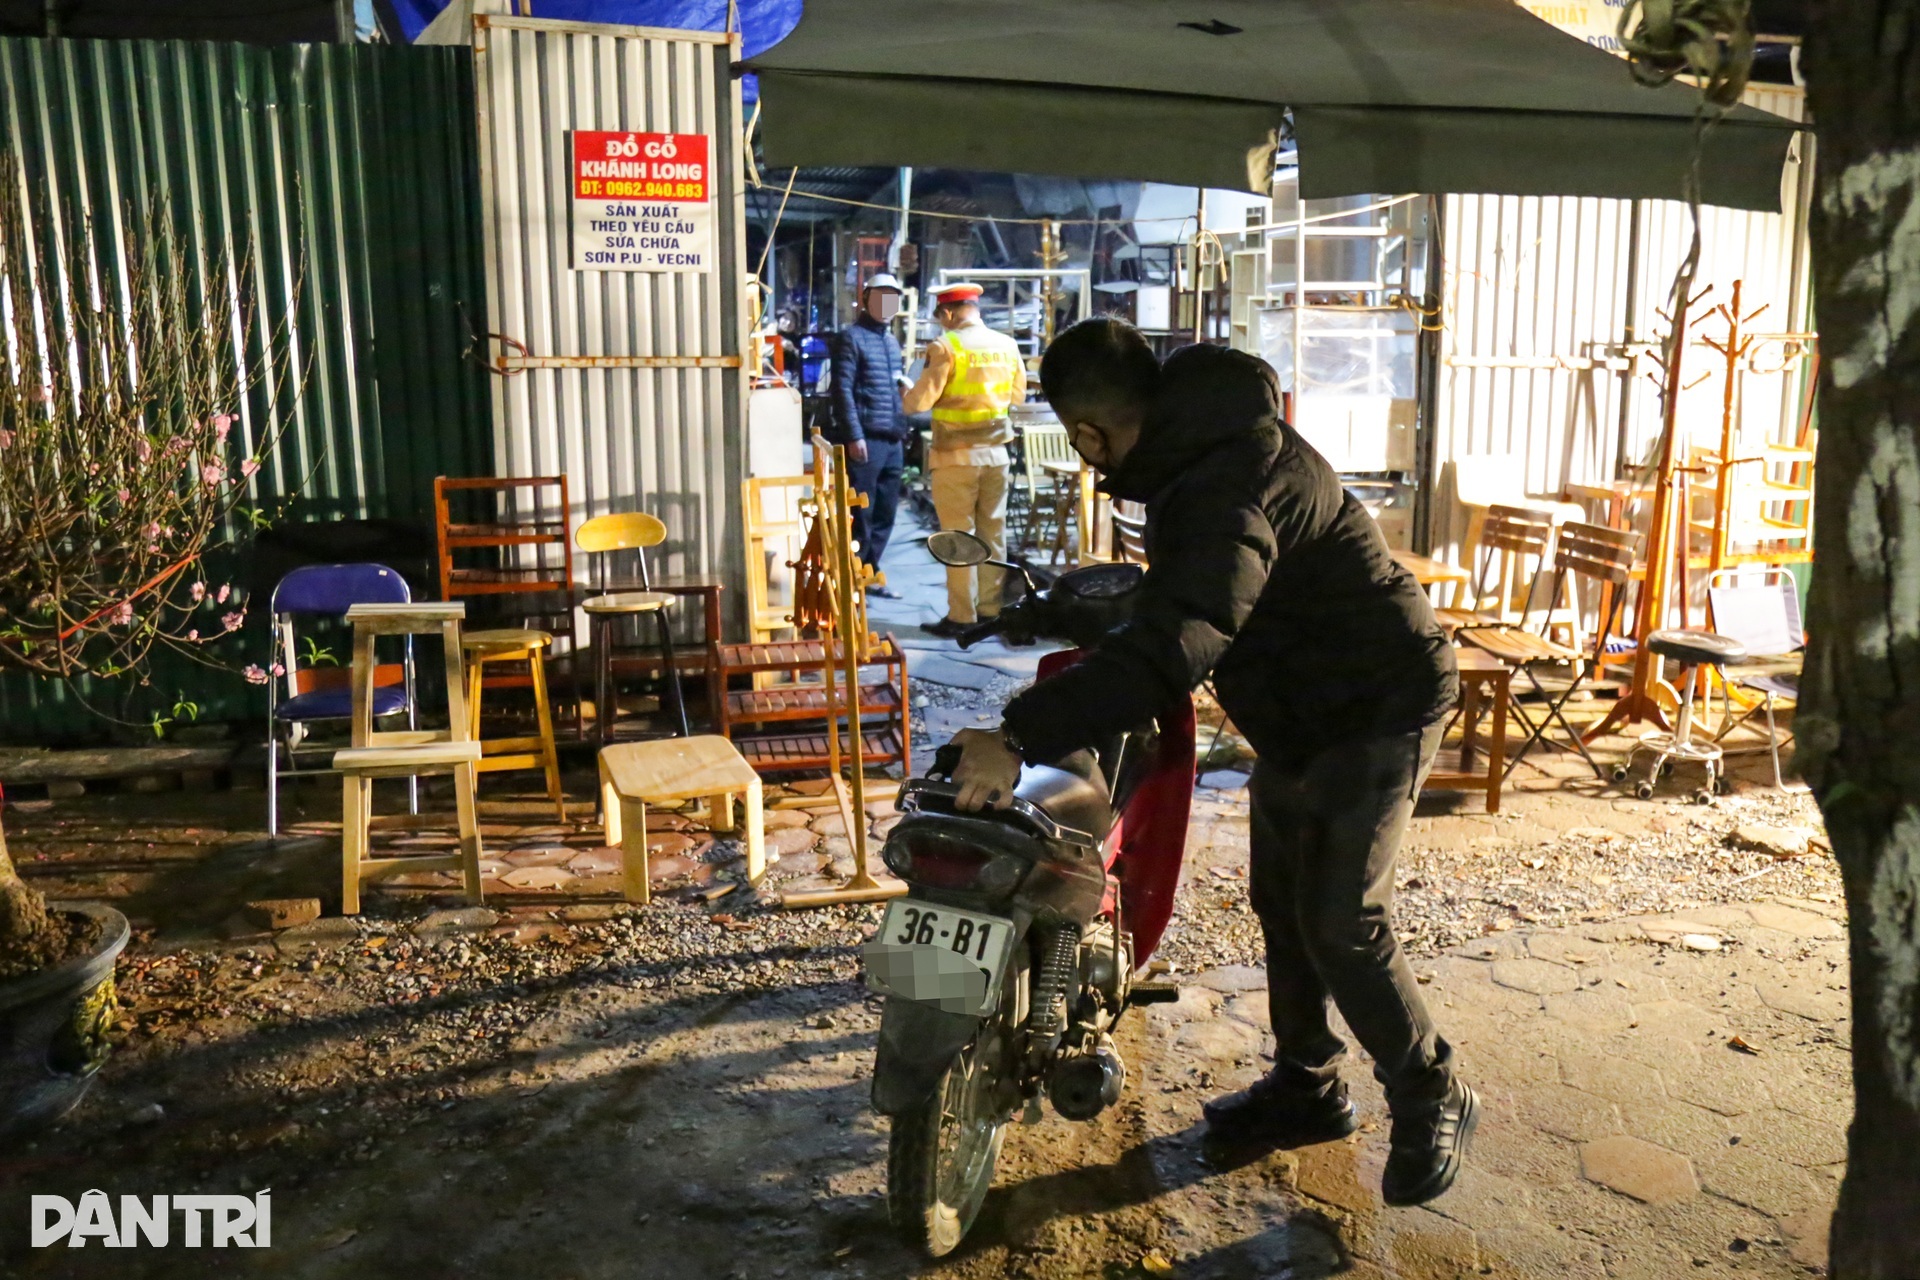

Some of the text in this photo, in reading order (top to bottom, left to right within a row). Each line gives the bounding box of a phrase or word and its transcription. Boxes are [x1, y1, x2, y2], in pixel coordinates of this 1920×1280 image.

[606, 134, 677, 158] ĐỒ GỖ
[581, 159, 702, 180] KHÁNH LONG
[581, 180, 703, 198] ĐT: 0962.940.683
[605, 202, 679, 218] SẢN XUẤT
[590, 220, 627, 233] THEO
[632, 219, 660, 233] YÊU
[605, 233, 680, 249] SỬA CHỮA
[585, 251, 615, 264] SƠN
[621, 252, 642, 264] P.U
[658, 253, 701, 266] VECNI
[898, 907, 992, 961] 36-B1
